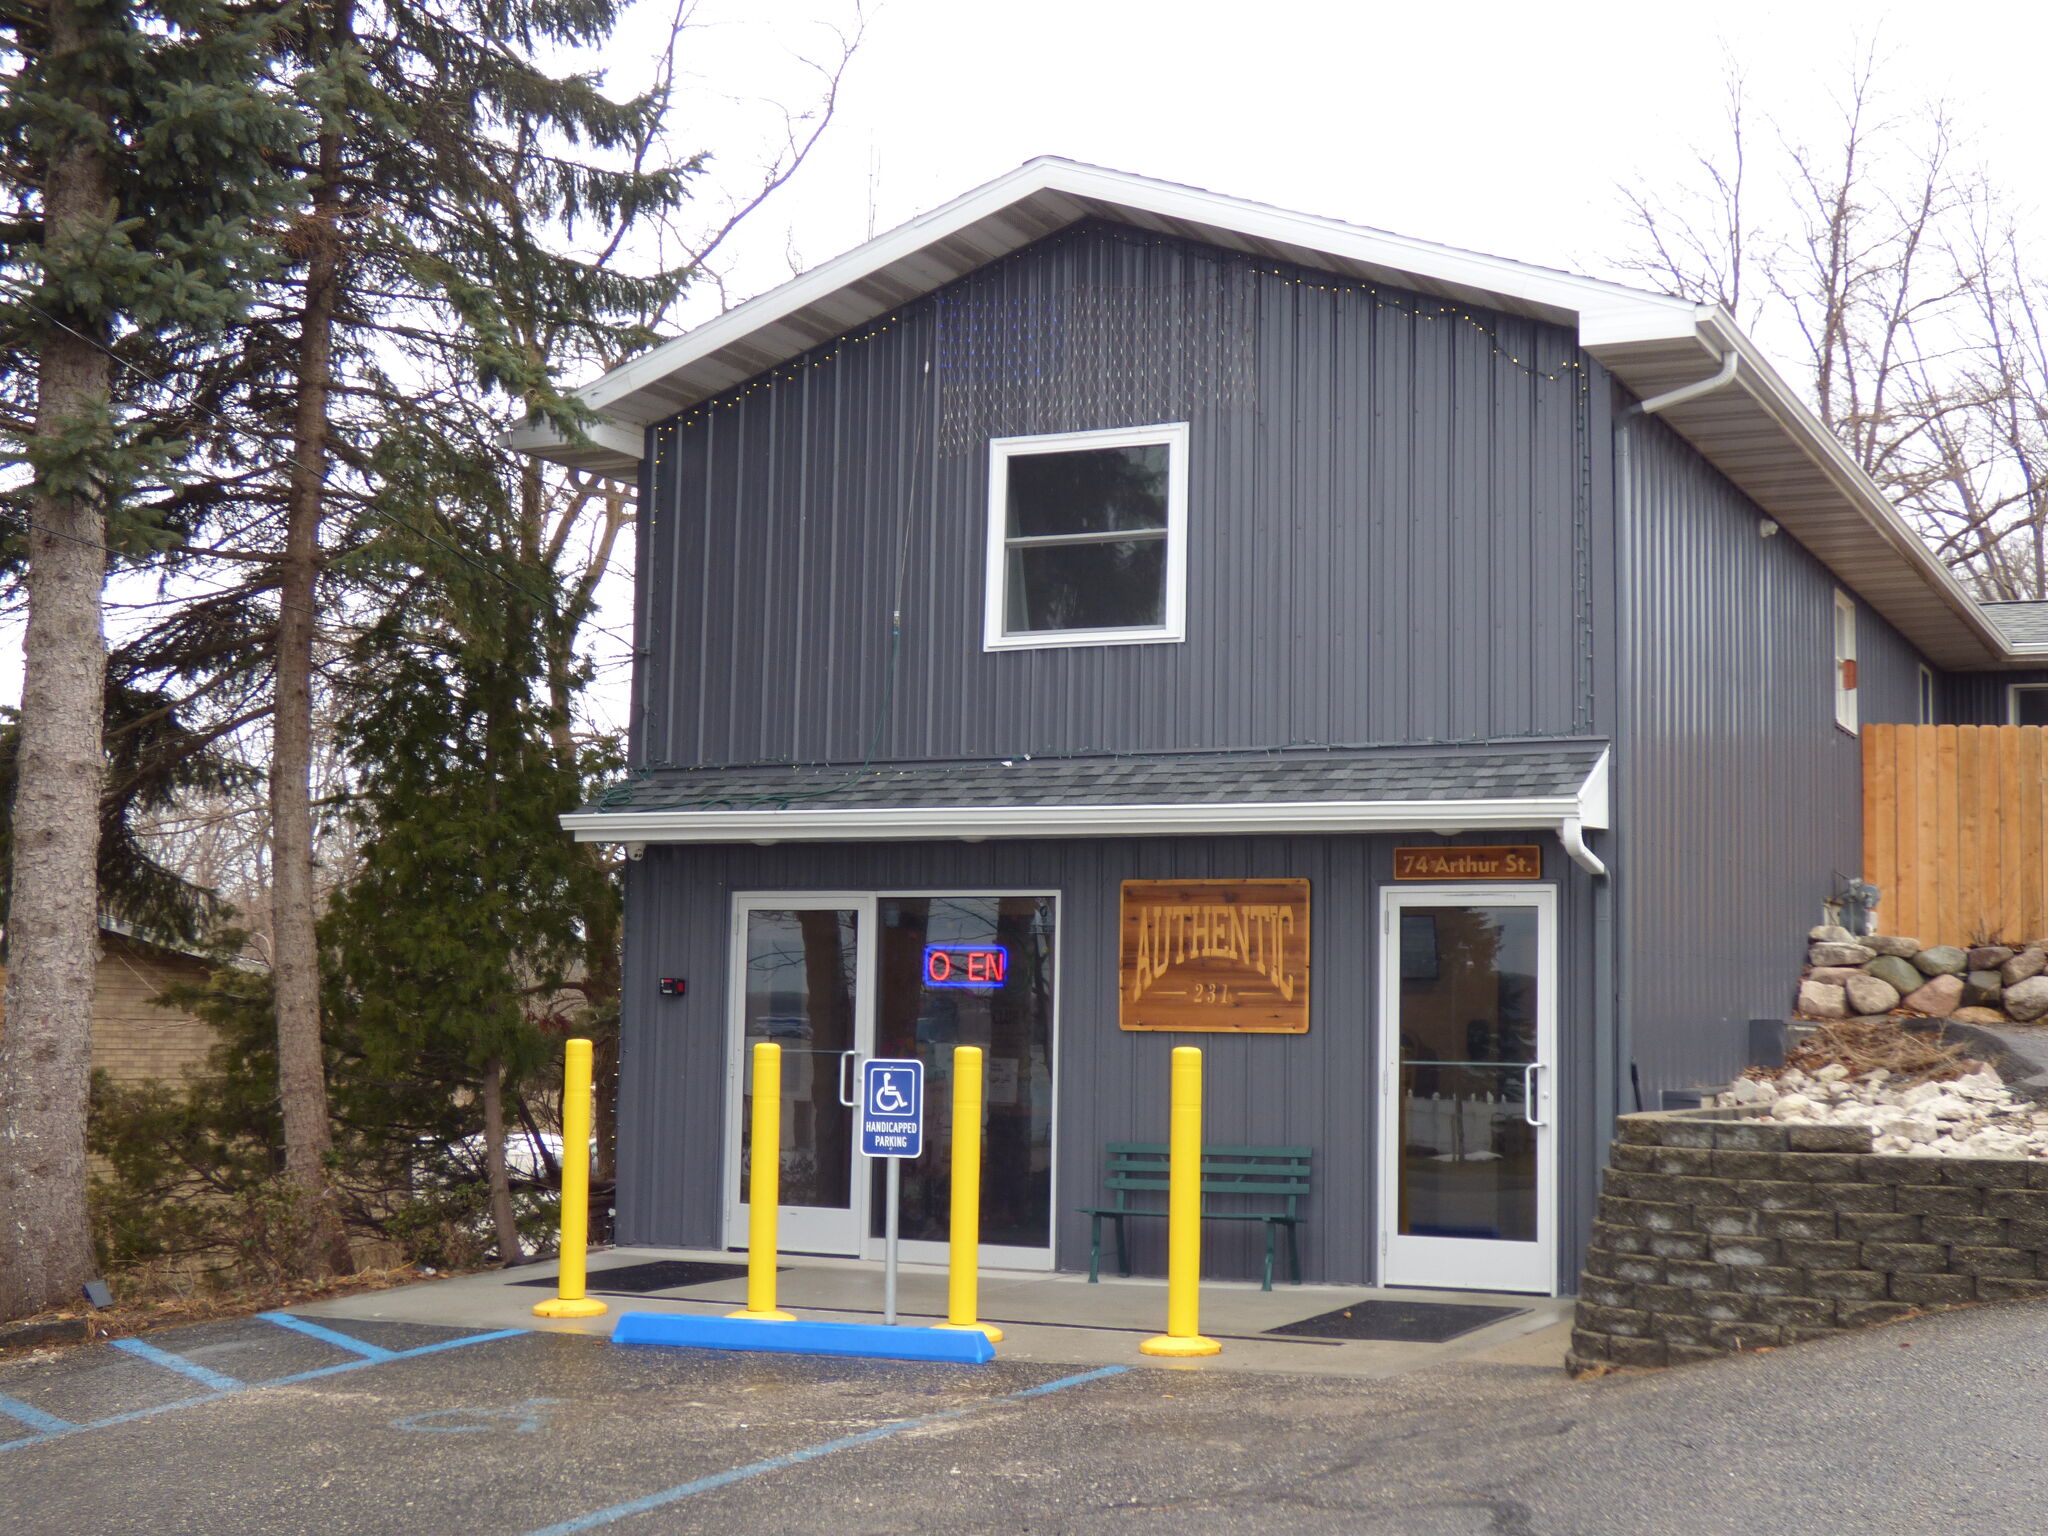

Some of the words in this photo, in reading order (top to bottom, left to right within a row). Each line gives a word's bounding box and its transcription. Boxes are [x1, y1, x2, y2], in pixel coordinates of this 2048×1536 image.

[1403, 855, 1428, 873] 74
[1434, 856, 1499, 873] Arthur
[1505, 854, 1532, 873] St.
[1134, 905, 1294, 1002] AUTHENTIC
[929, 951, 1004, 981] OEN
[1193, 983, 1229, 1004] 231
[865, 1121, 917, 1134] HANDICAPPED
[874, 1135, 908, 1148] PARKING
